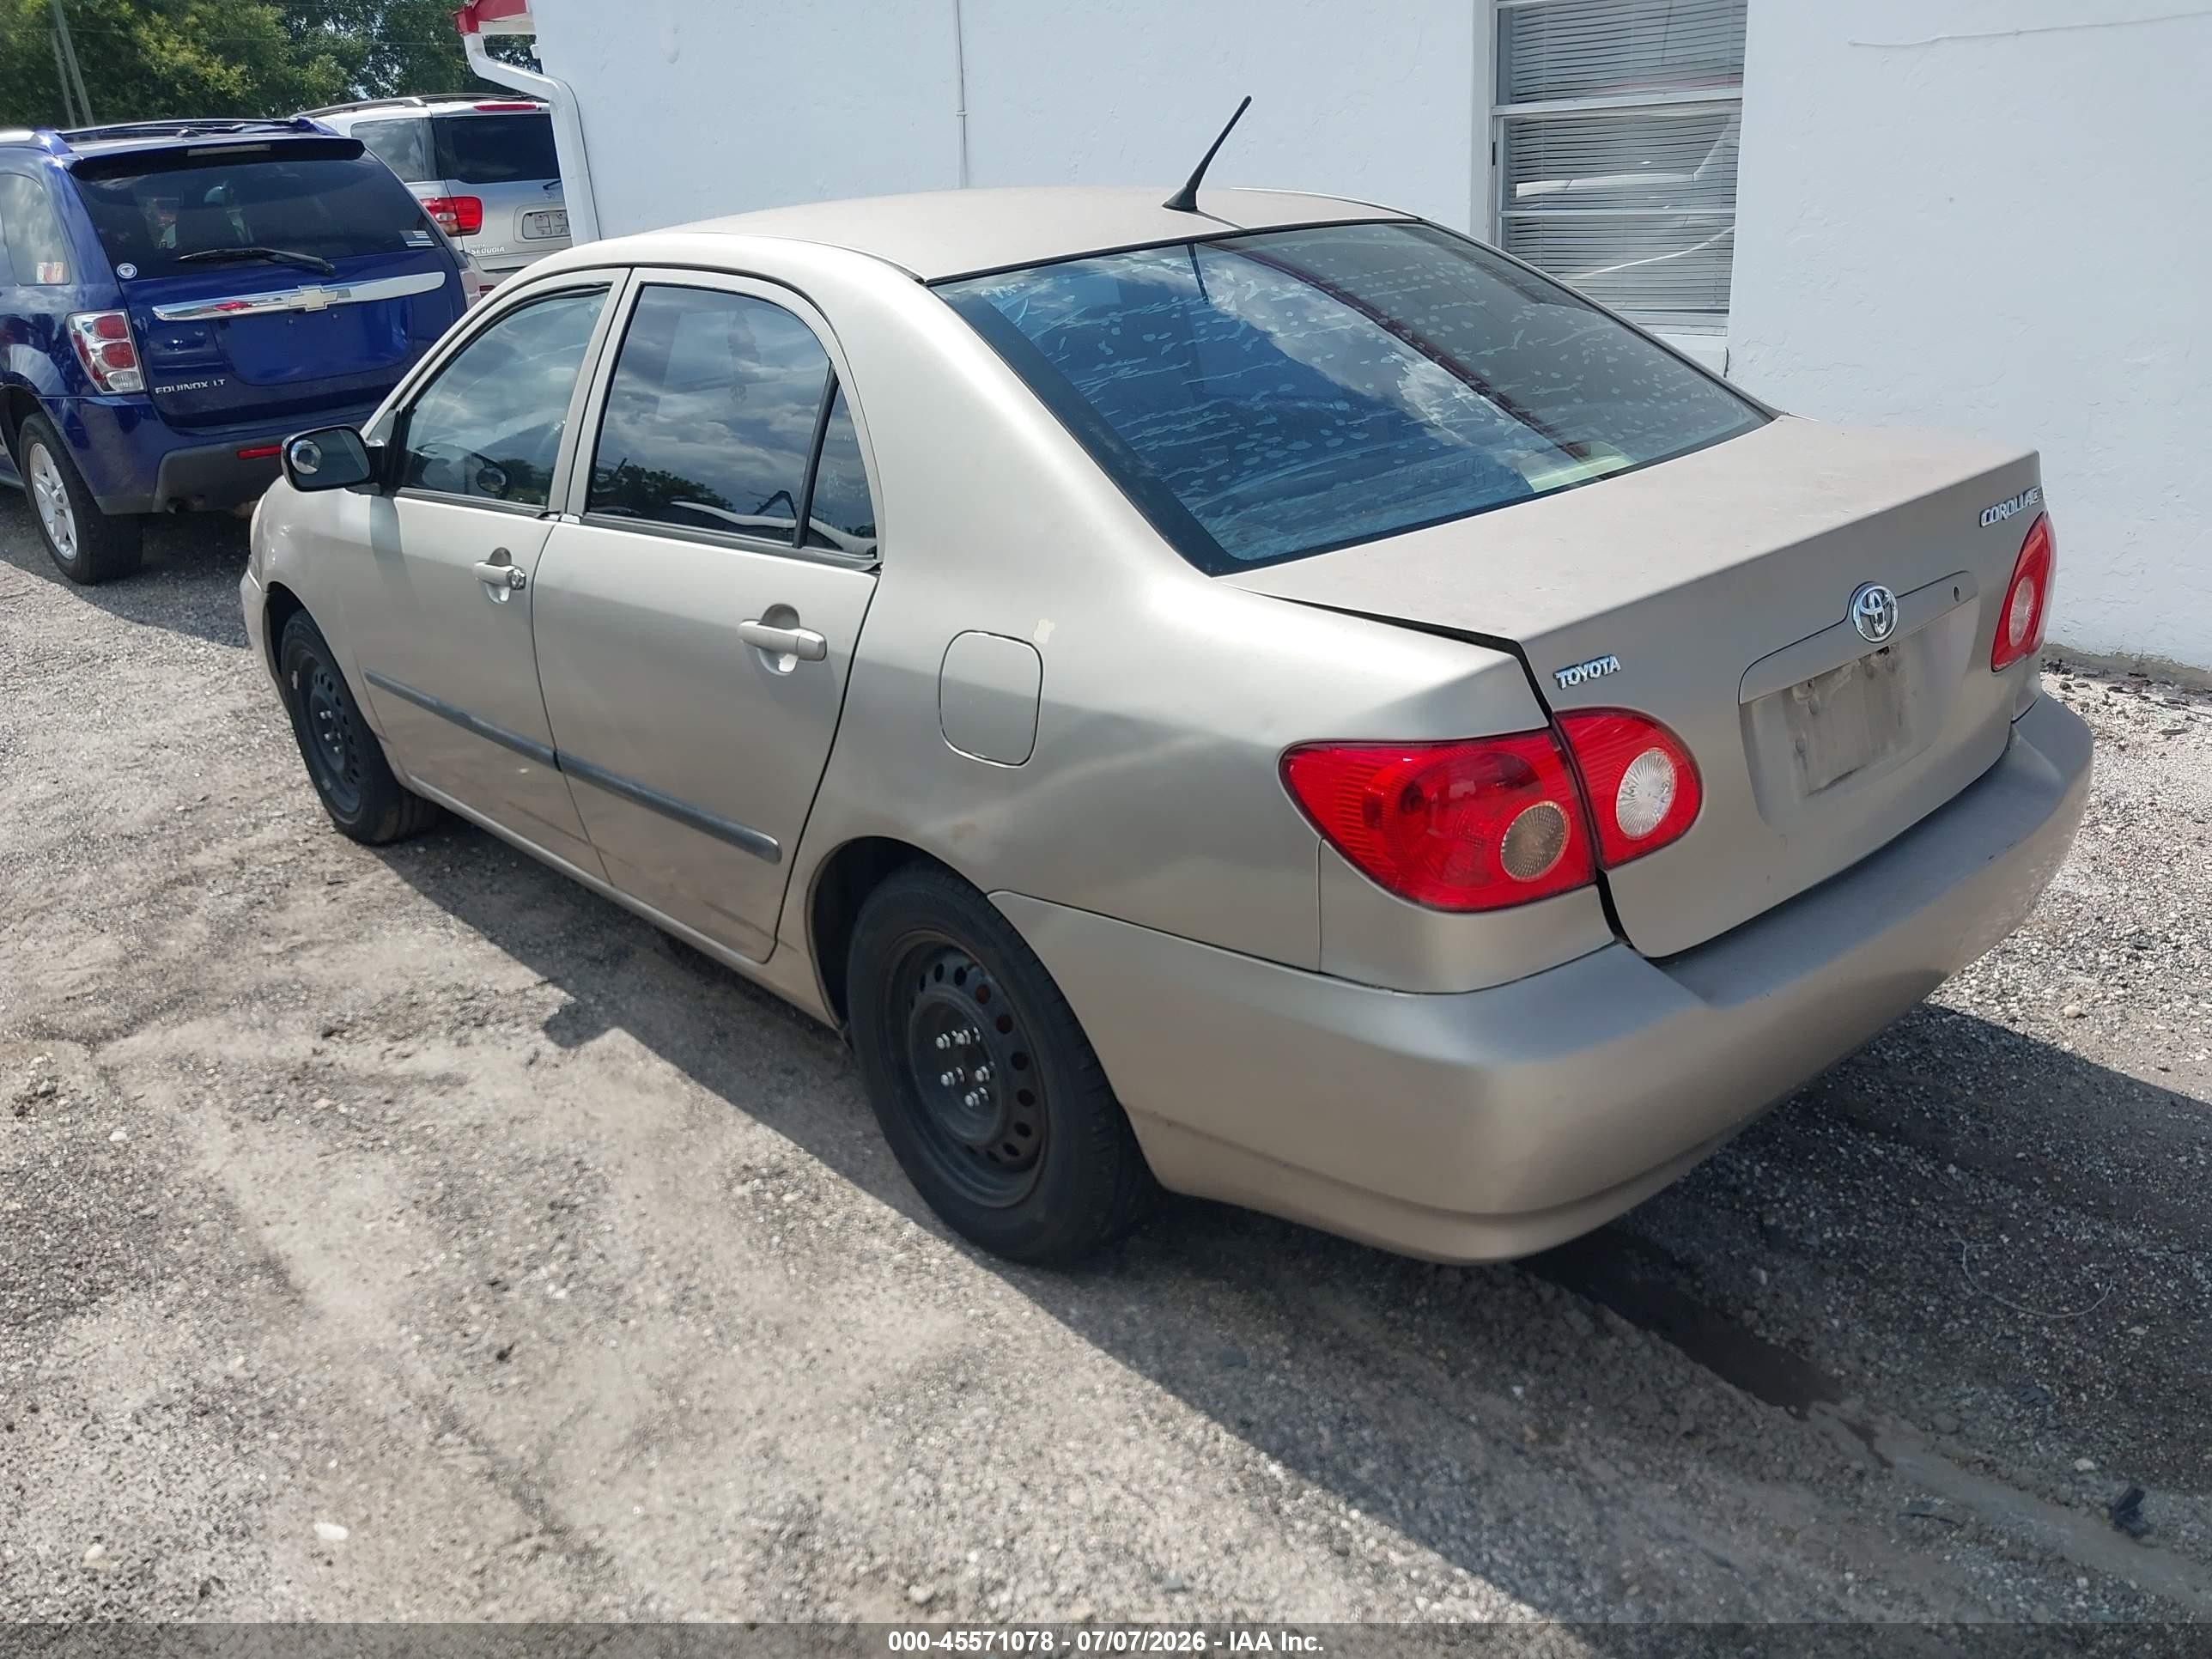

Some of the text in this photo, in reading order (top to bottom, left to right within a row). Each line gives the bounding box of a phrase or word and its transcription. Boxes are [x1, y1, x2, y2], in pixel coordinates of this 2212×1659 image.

[471, 246, 505, 255] SEQUOIA
[155, 380, 209, 394] EQUINOX
[1554, 654, 1621, 690] TOYOTA
